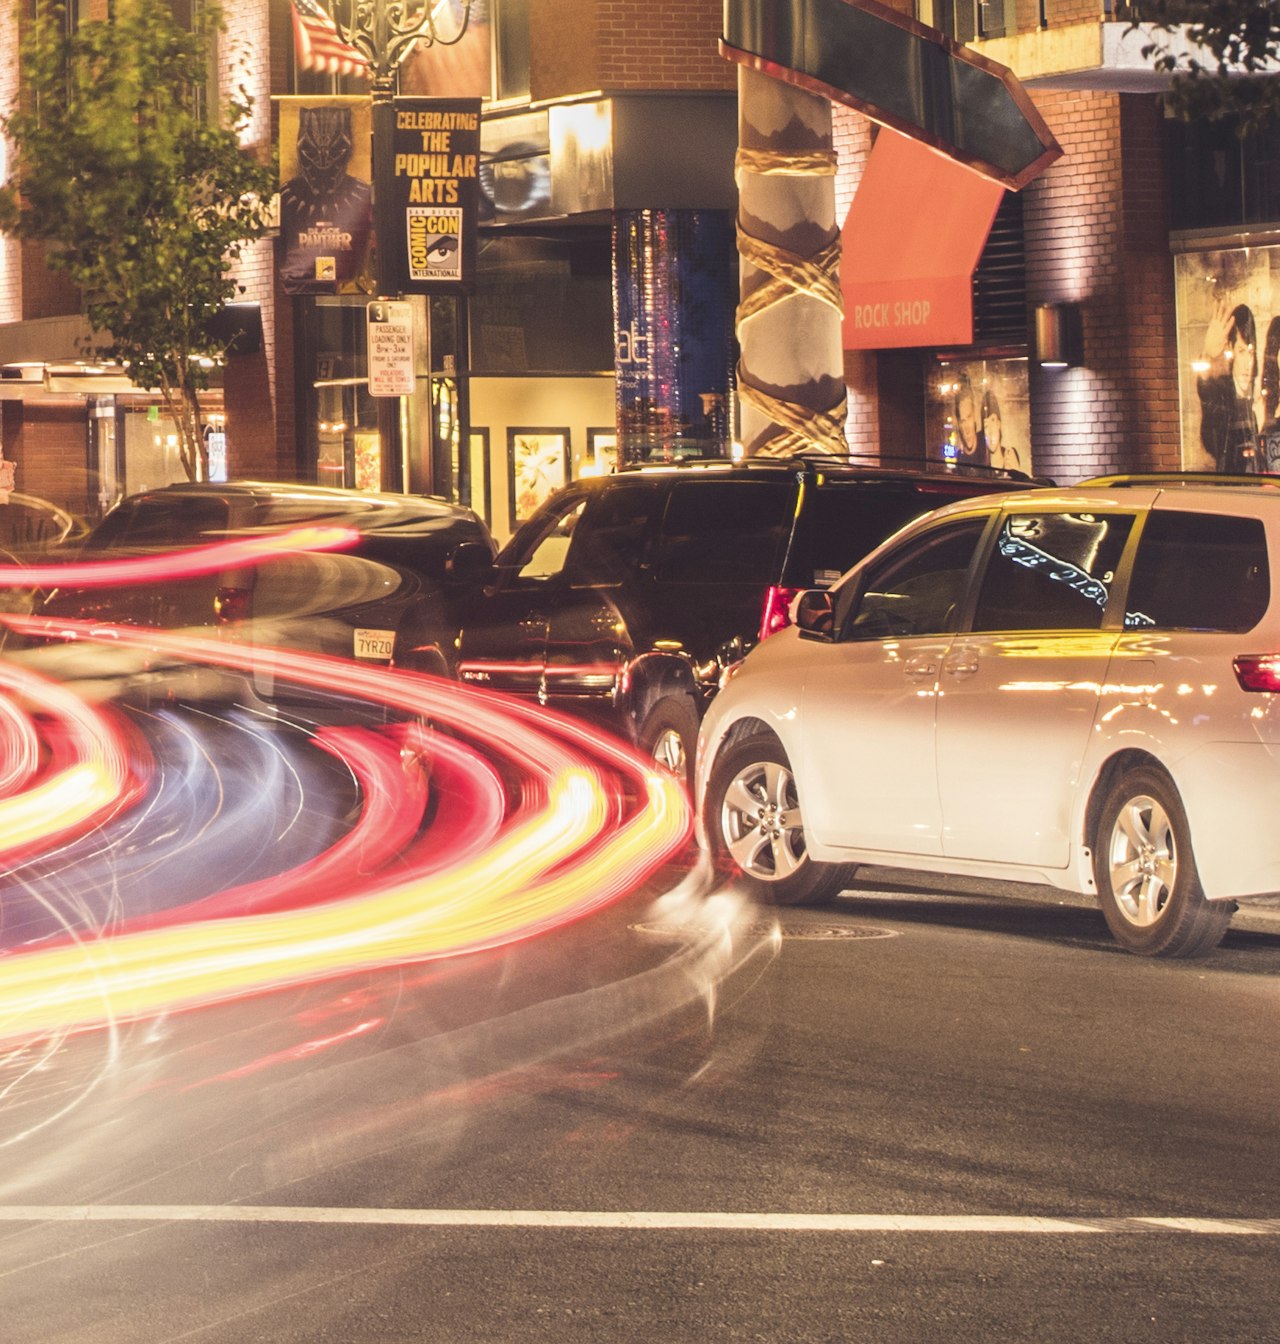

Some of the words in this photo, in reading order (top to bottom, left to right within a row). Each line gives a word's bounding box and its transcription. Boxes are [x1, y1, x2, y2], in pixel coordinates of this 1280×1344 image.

[397, 112, 478, 131] CELEBRATING
[421, 131, 451, 153] THE
[395, 153, 477, 178] POPULAR
[408, 178, 459, 204] ARTS
[426, 215, 459, 234] CON
[298, 232, 353, 251] PANTHER
[410, 215, 427, 269] COMIC
[412, 269, 459, 278] INTERNATIONAL
[375, 305, 384, 321] 3
[855, 304, 890, 329] ROCK
[894, 300, 931, 326] SHOP
[375, 325, 407, 334] PASSENGER
[371, 335, 395, 344] LOADING
[396, 335, 411, 344] ONLY
